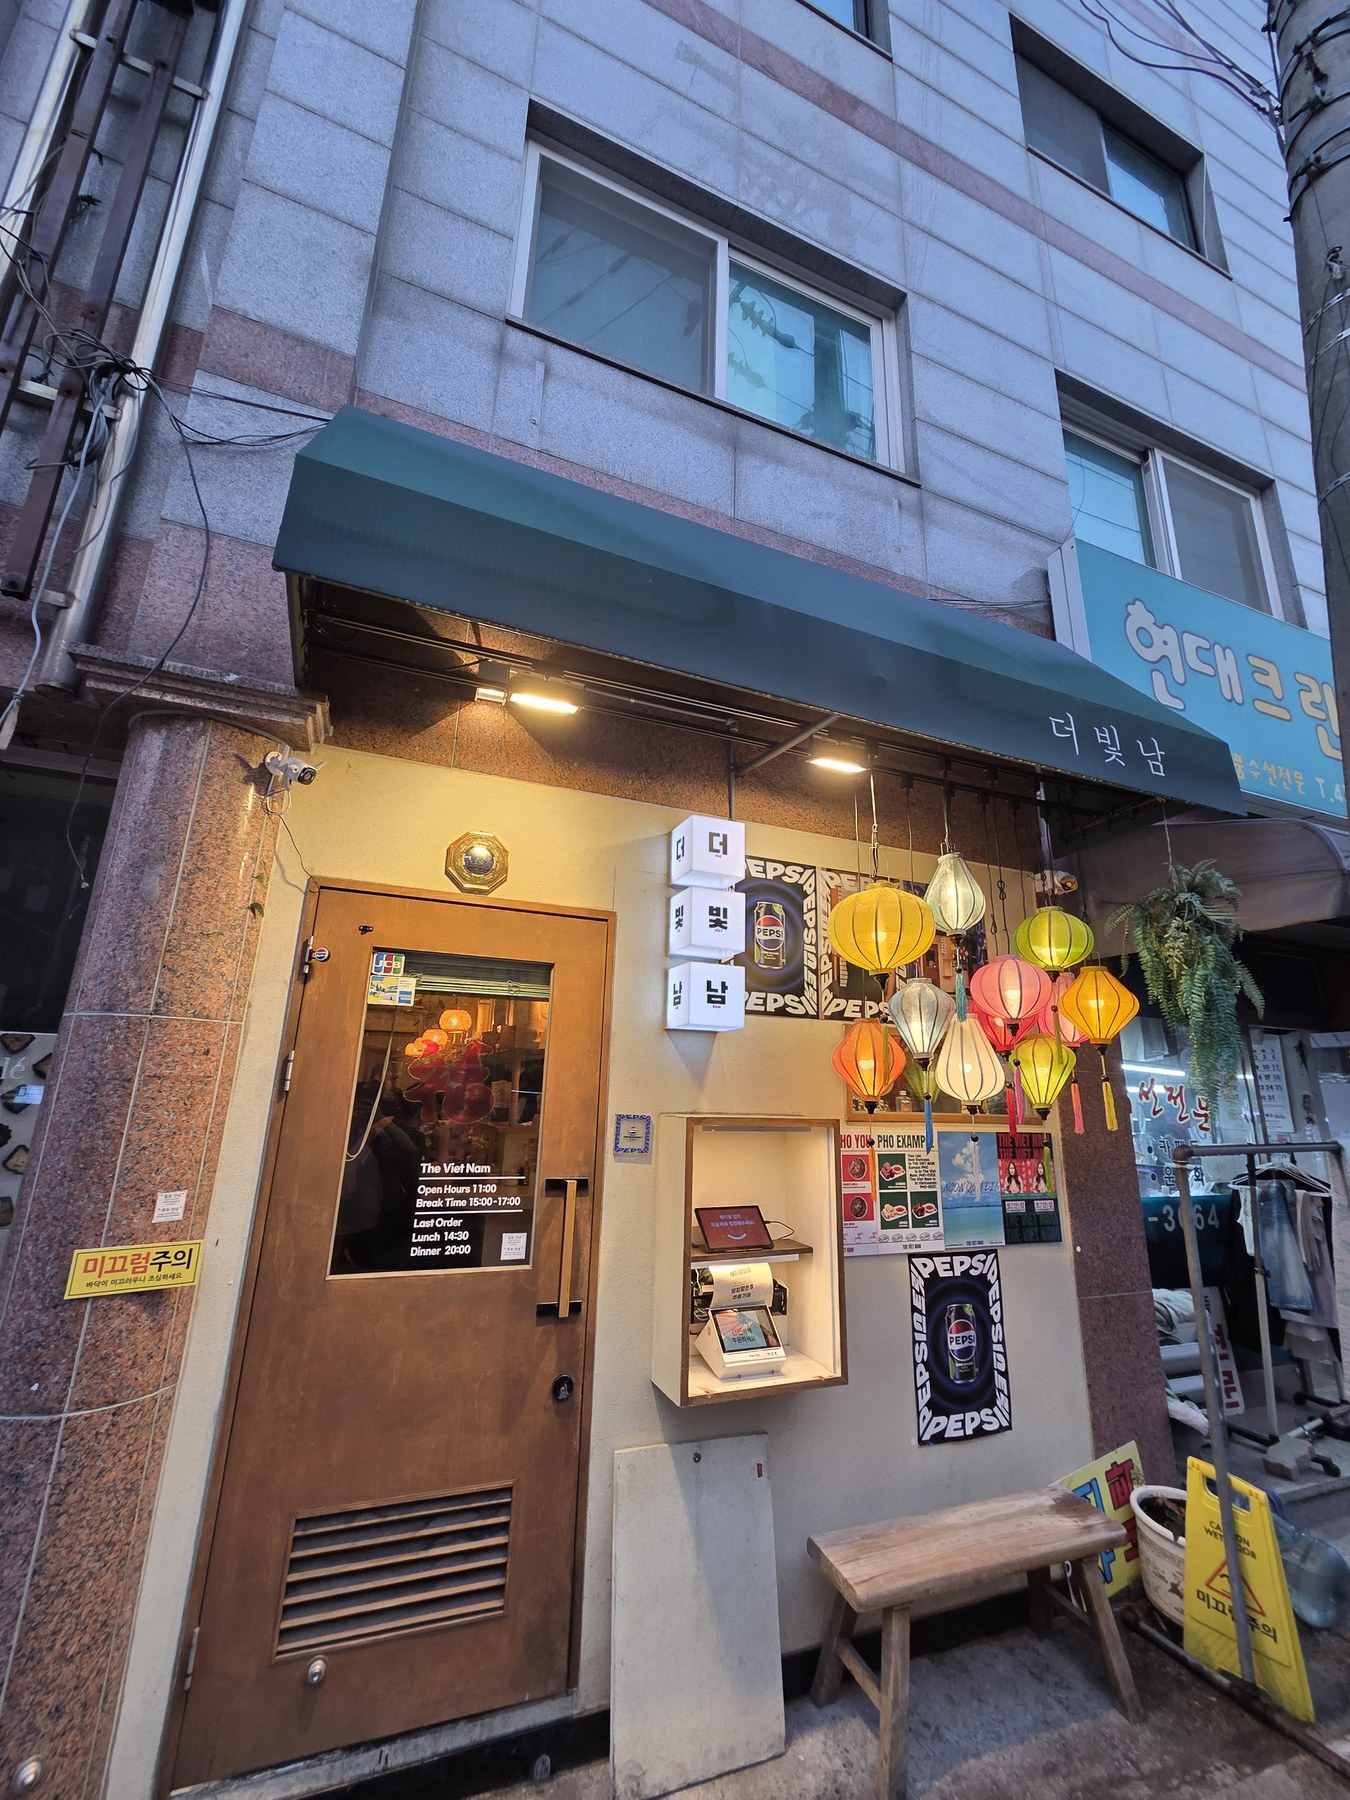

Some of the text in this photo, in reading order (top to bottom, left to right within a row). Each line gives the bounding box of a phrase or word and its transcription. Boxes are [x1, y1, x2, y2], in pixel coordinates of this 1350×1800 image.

[1125, 598, 1342, 760] 현대크린
[1049, 712, 1165, 776] 더 빛 남
[1315, 776, 1346, 804] T.4
[708, 831, 728, 856] 더
[745, 858, 812, 884] EPSI
[673, 835, 685, 1006] 더 빛 남
[708, 905, 728, 930] 빛
[757, 927, 784, 938] PEPSI
[706, 979, 729, 1005] 남
[823, 998, 893, 1020] PEPS
[1130, 1077, 1212, 1133] 선전문
[840, 1134, 852, 1149] HO
[877, 1134, 934, 1148] PHO EXAMP
[420, 1162, 491, 1174] The Viet Nam
[1162, 1164, 1206, 1187] 운화
[417, 1184, 497, 1196] Open Hours 11:00
[416, 1198, 443, 1208] Break
[445, 1198, 467, 1207] Time
[413, 1218, 463, 1228] Last Order
[1148, 1203, 1220, 1232] -364
[411, 1231, 469, 1242] Lunch 14:30
[410, 1245, 471, 1257] Dinner 20:00
[912, 1253, 997, 1279] PEPSI
[86, 1272, 182, 1288] 바닥이 미끄러우니 조심하세요
[949, 1334, 976, 1345] PEPSI
[921, 1405, 1010, 1441] PEPSI
[1204, 1526, 1224, 1542] WET
[1209, 1521, 1251, 1547] CAON
